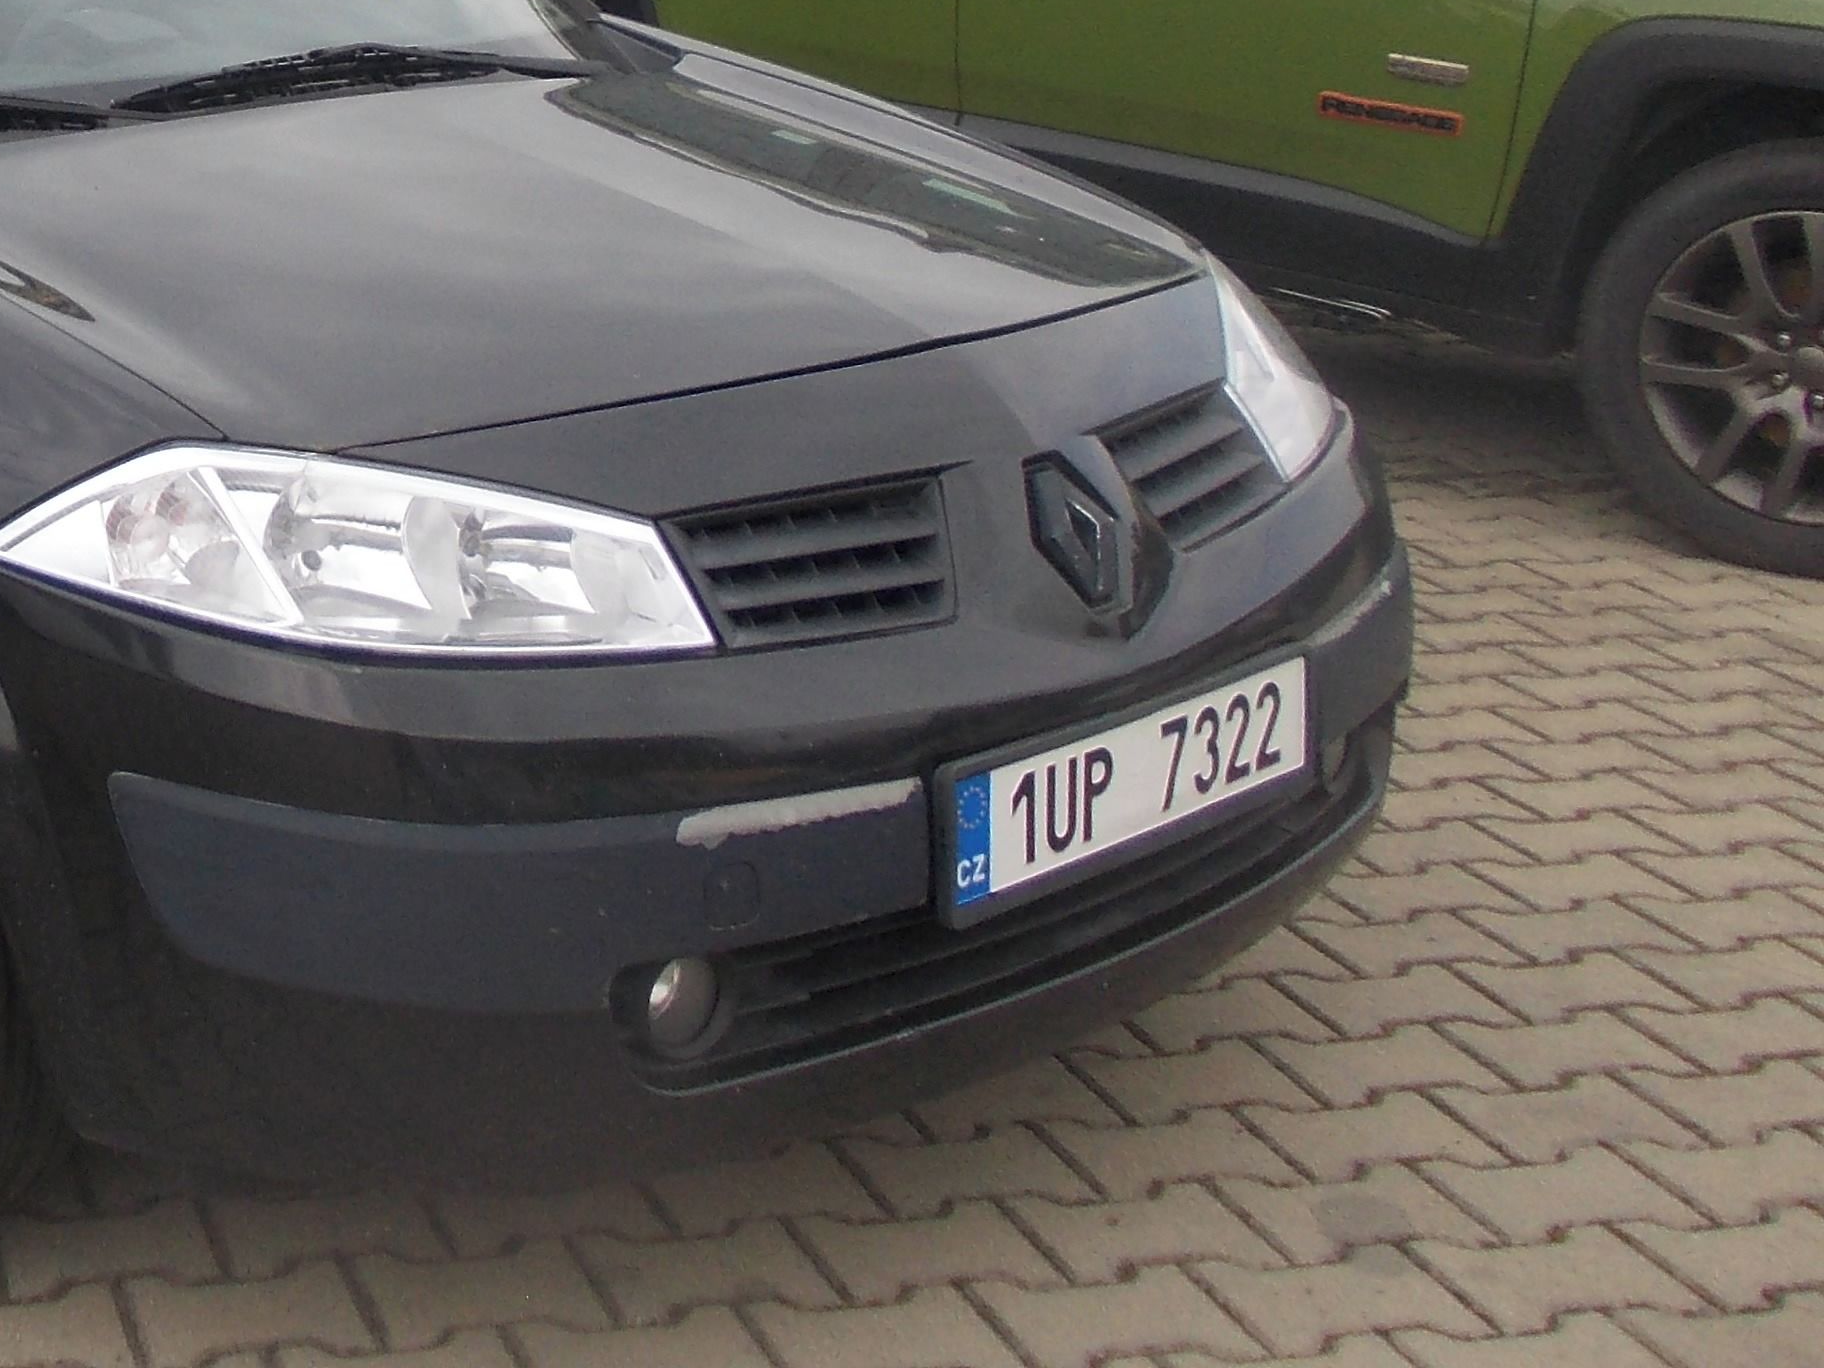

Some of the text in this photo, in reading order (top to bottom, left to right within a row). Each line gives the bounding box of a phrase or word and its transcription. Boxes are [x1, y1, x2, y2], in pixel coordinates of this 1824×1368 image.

[1010, 681, 1282, 864] 1UP 7322
[956, 853, 986, 889] CZ
